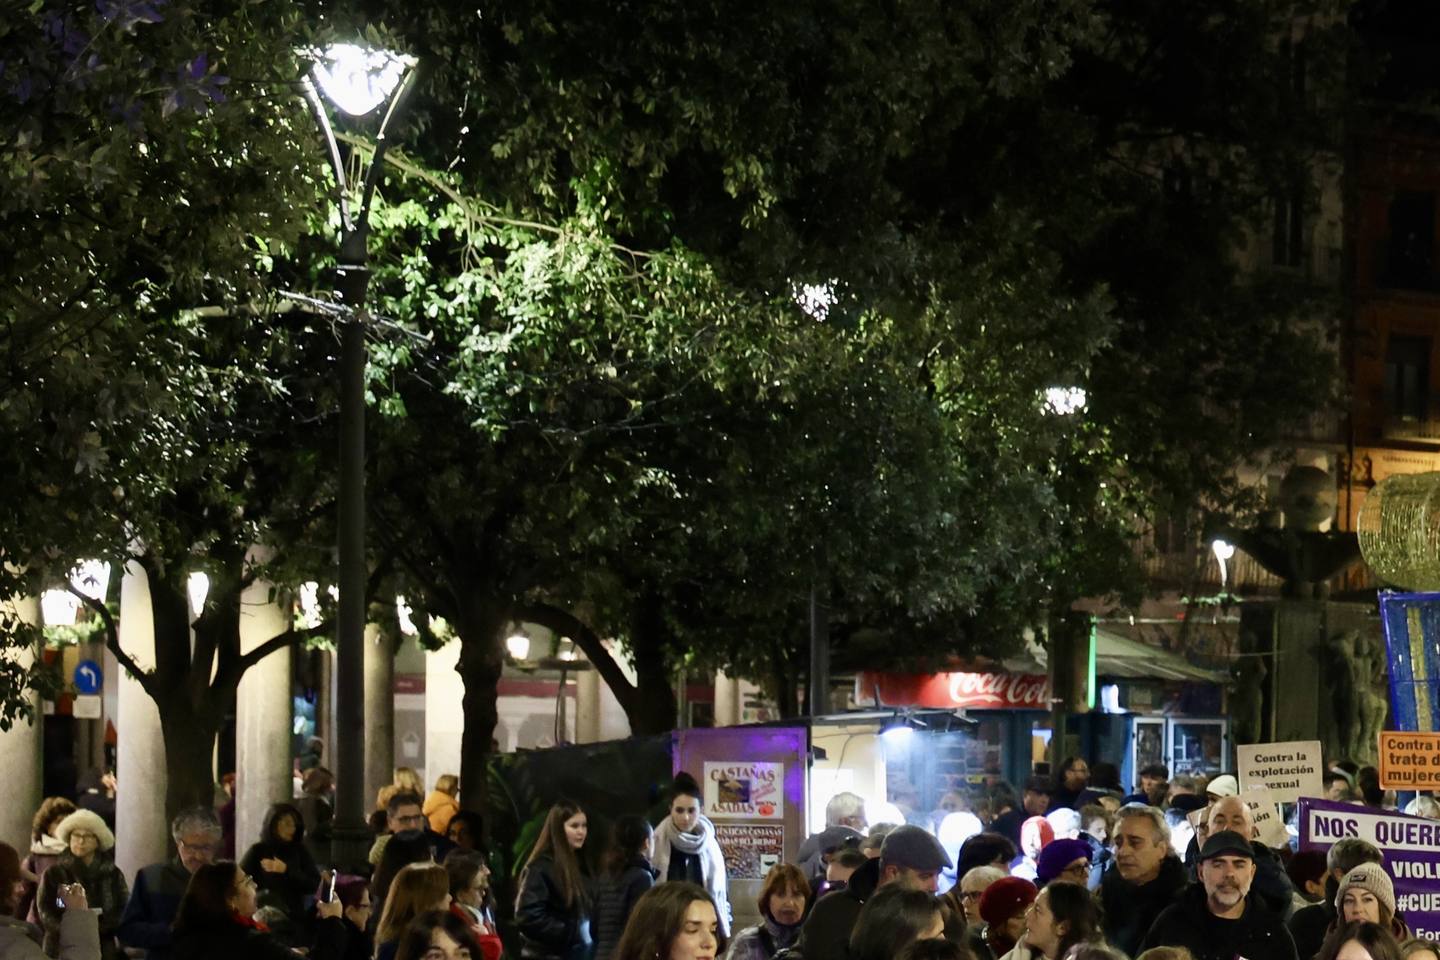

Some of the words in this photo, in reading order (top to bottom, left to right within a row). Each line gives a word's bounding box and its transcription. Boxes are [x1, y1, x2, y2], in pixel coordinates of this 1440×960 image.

[1387, 738, 1432, 751] Contra
[1254, 754, 1294, 763] Contra
[1296, 752, 1307, 761] la
[1389, 752, 1427, 766] trata
[711, 764, 775, 781] CASTAÑAS
[1248, 765, 1314, 778] explotación
[711, 802, 755, 814] ASADAS
[1314, 815, 1359, 838] NOS
